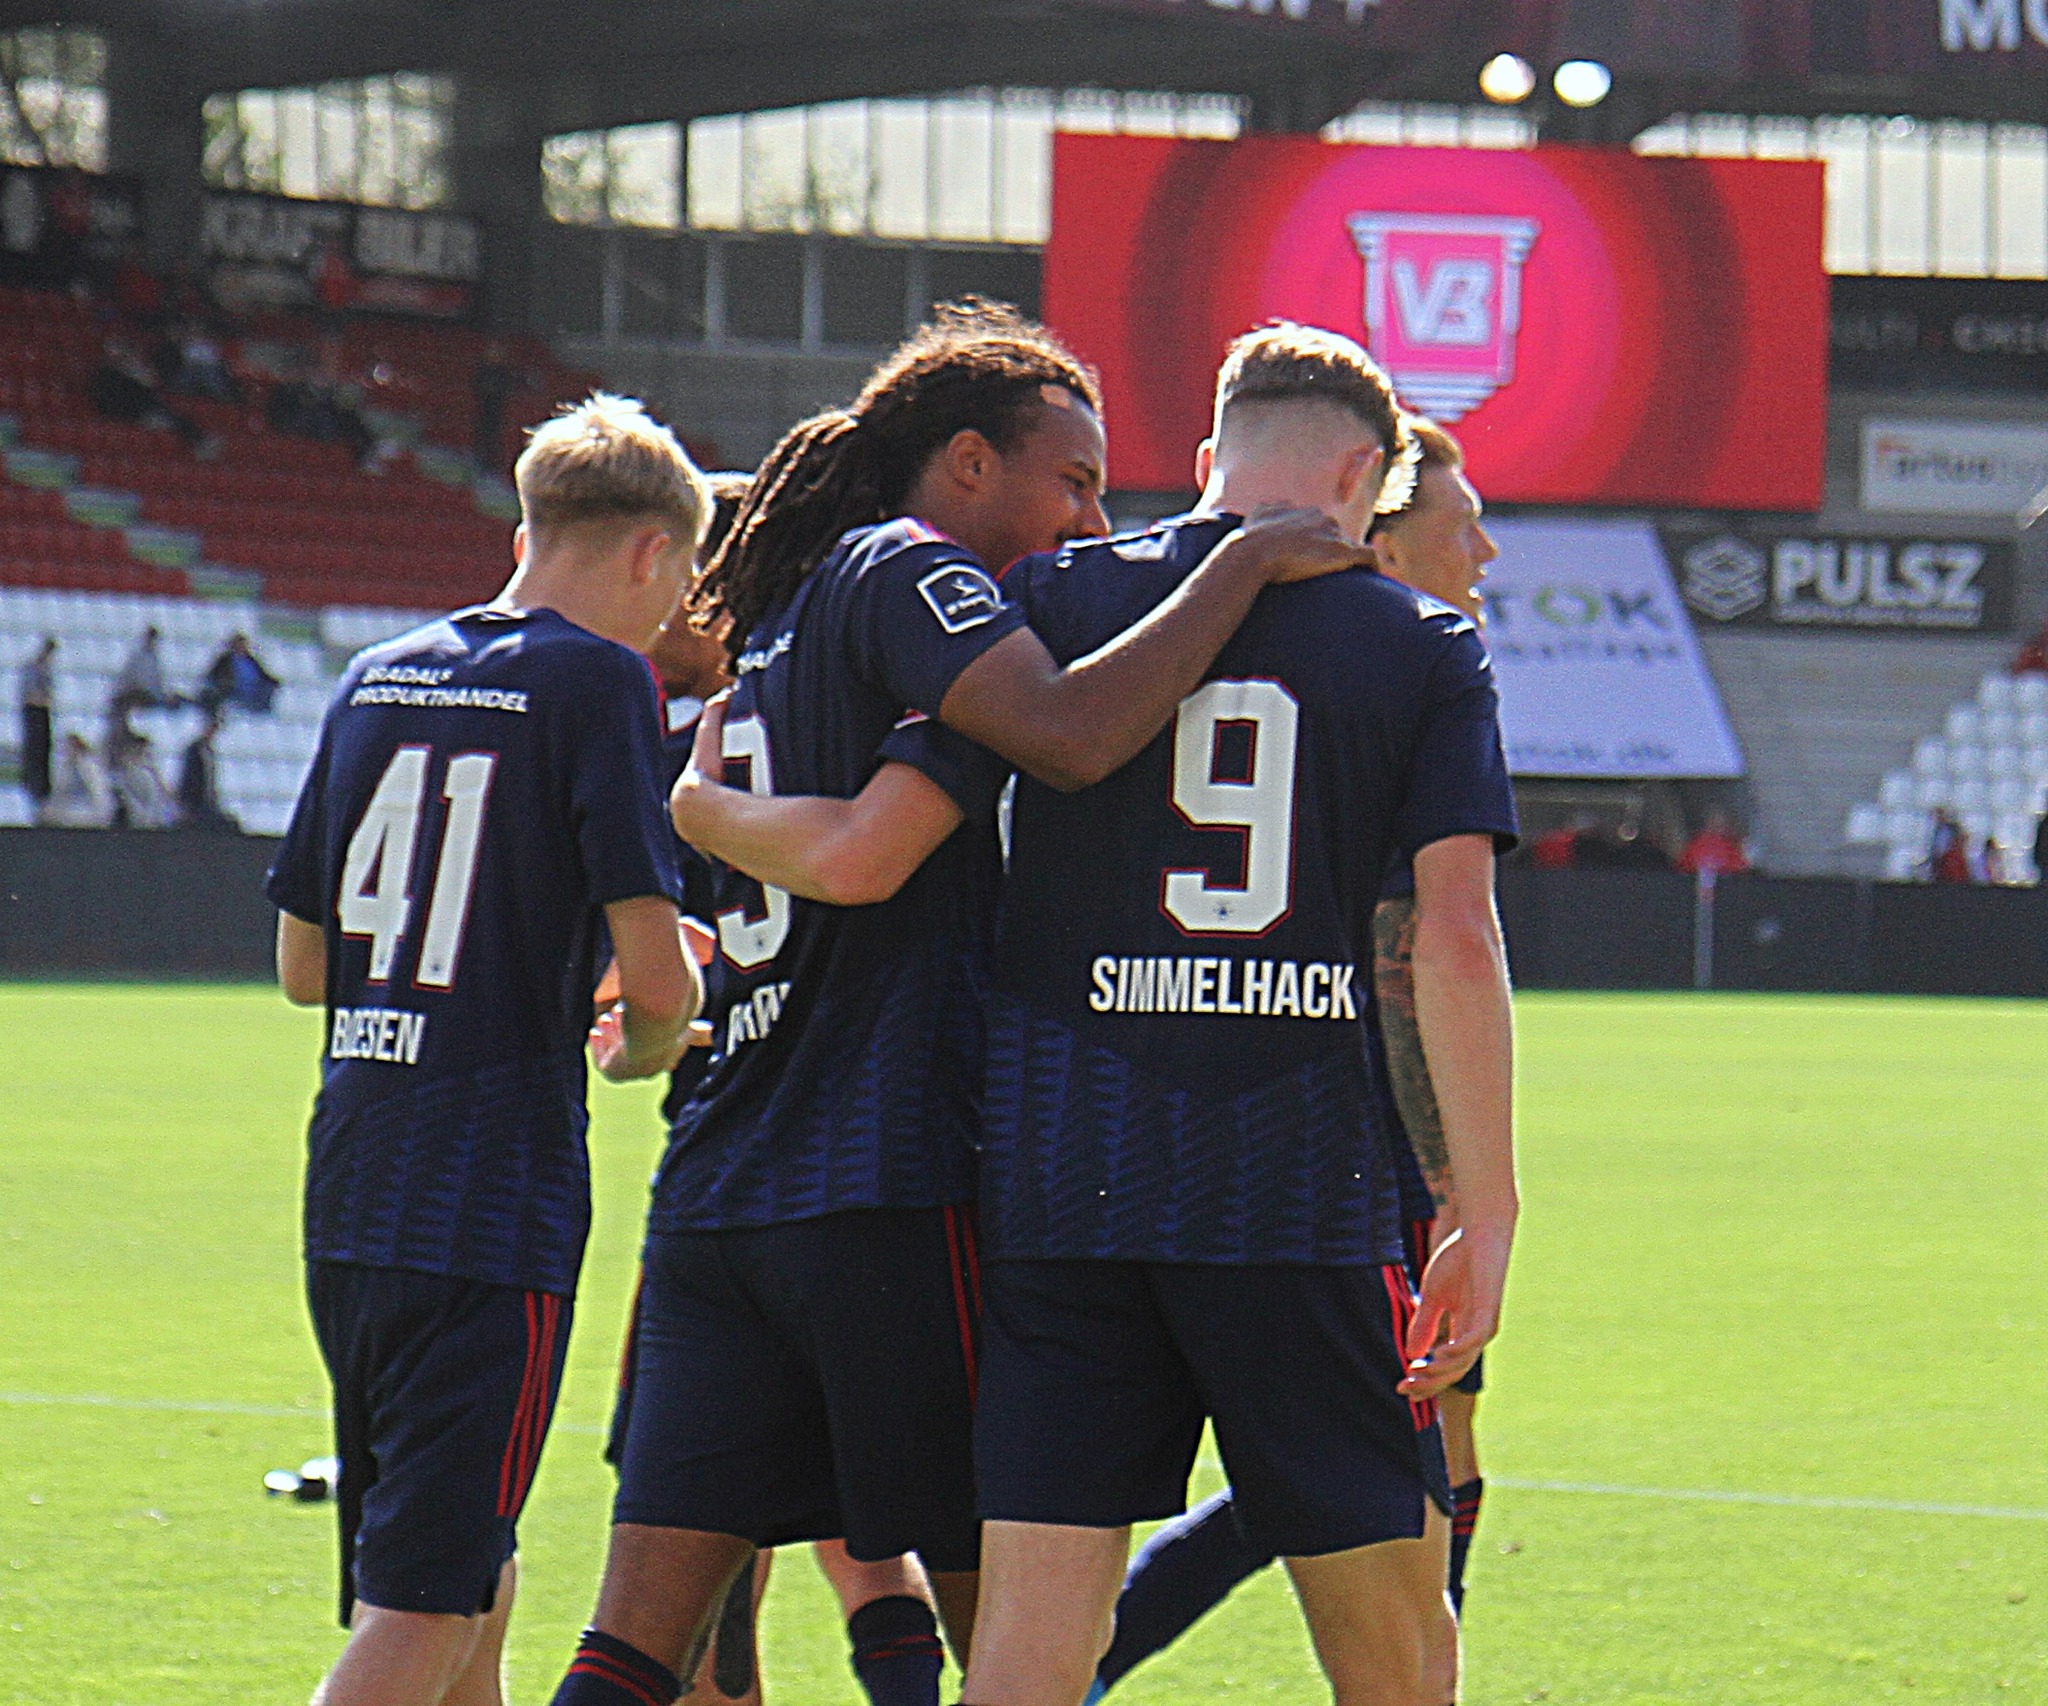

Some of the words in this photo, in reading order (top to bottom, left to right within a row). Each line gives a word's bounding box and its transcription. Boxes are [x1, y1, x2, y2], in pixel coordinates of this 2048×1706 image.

[391, 258, 493, 345] VB
[1773, 539, 1986, 608] PULSZ
[1159, 675, 1300, 939] 9
[335, 745, 499, 991] 41
[1089, 956, 1358, 1021] SIMMELHACK
